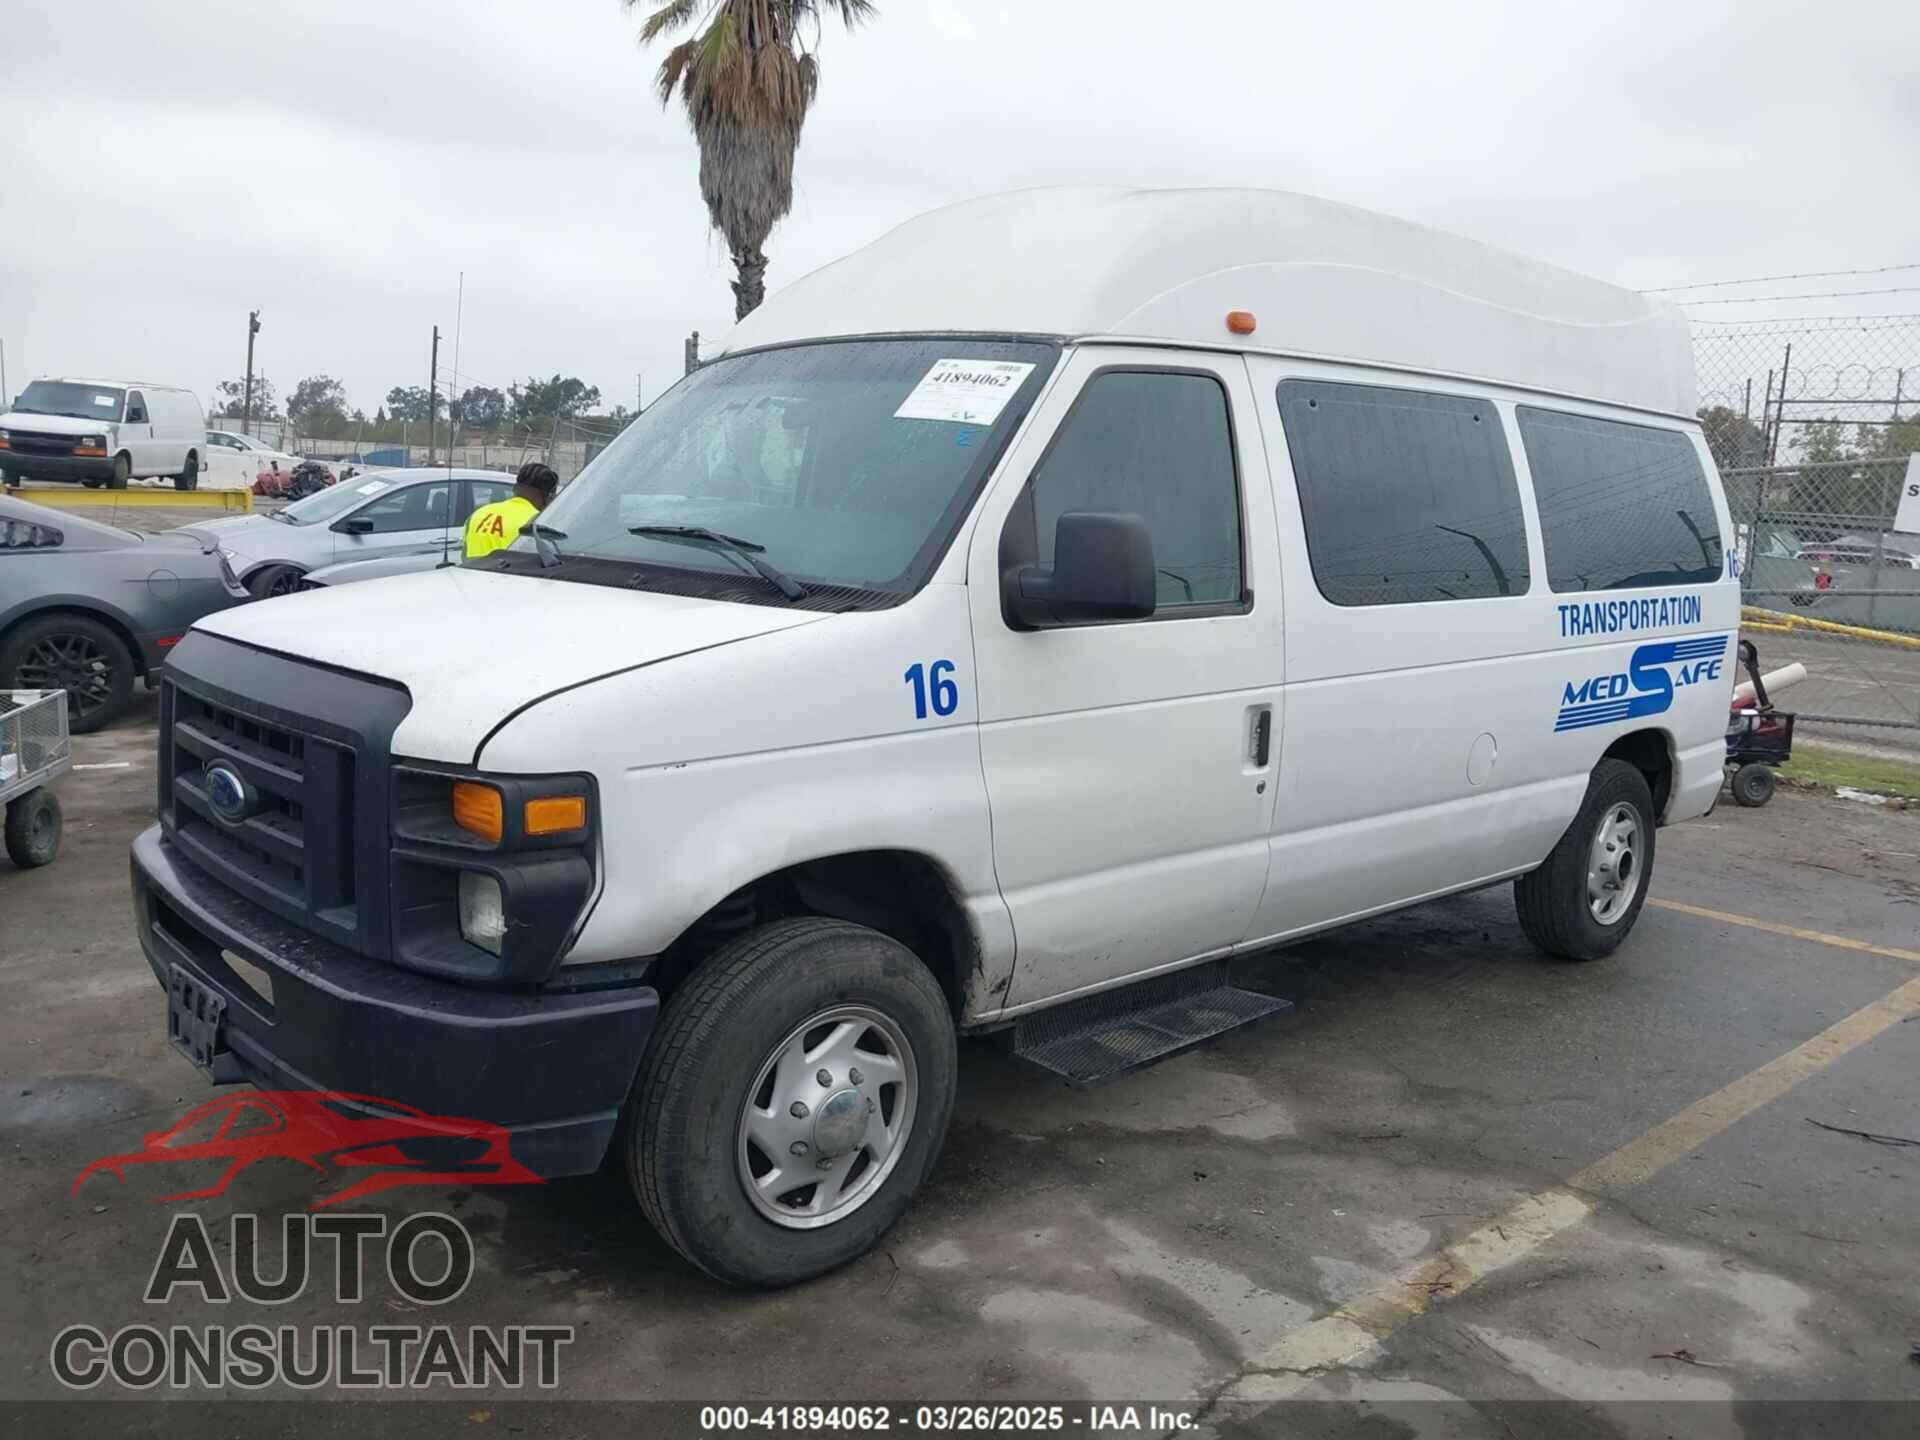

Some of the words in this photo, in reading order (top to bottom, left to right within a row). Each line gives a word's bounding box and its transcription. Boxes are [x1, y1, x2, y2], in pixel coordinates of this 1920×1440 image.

[933, 371, 1011, 387] 41894062
[1558, 596, 1701, 637] TRANSPORTATION
[904, 659, 958, 719] 16
